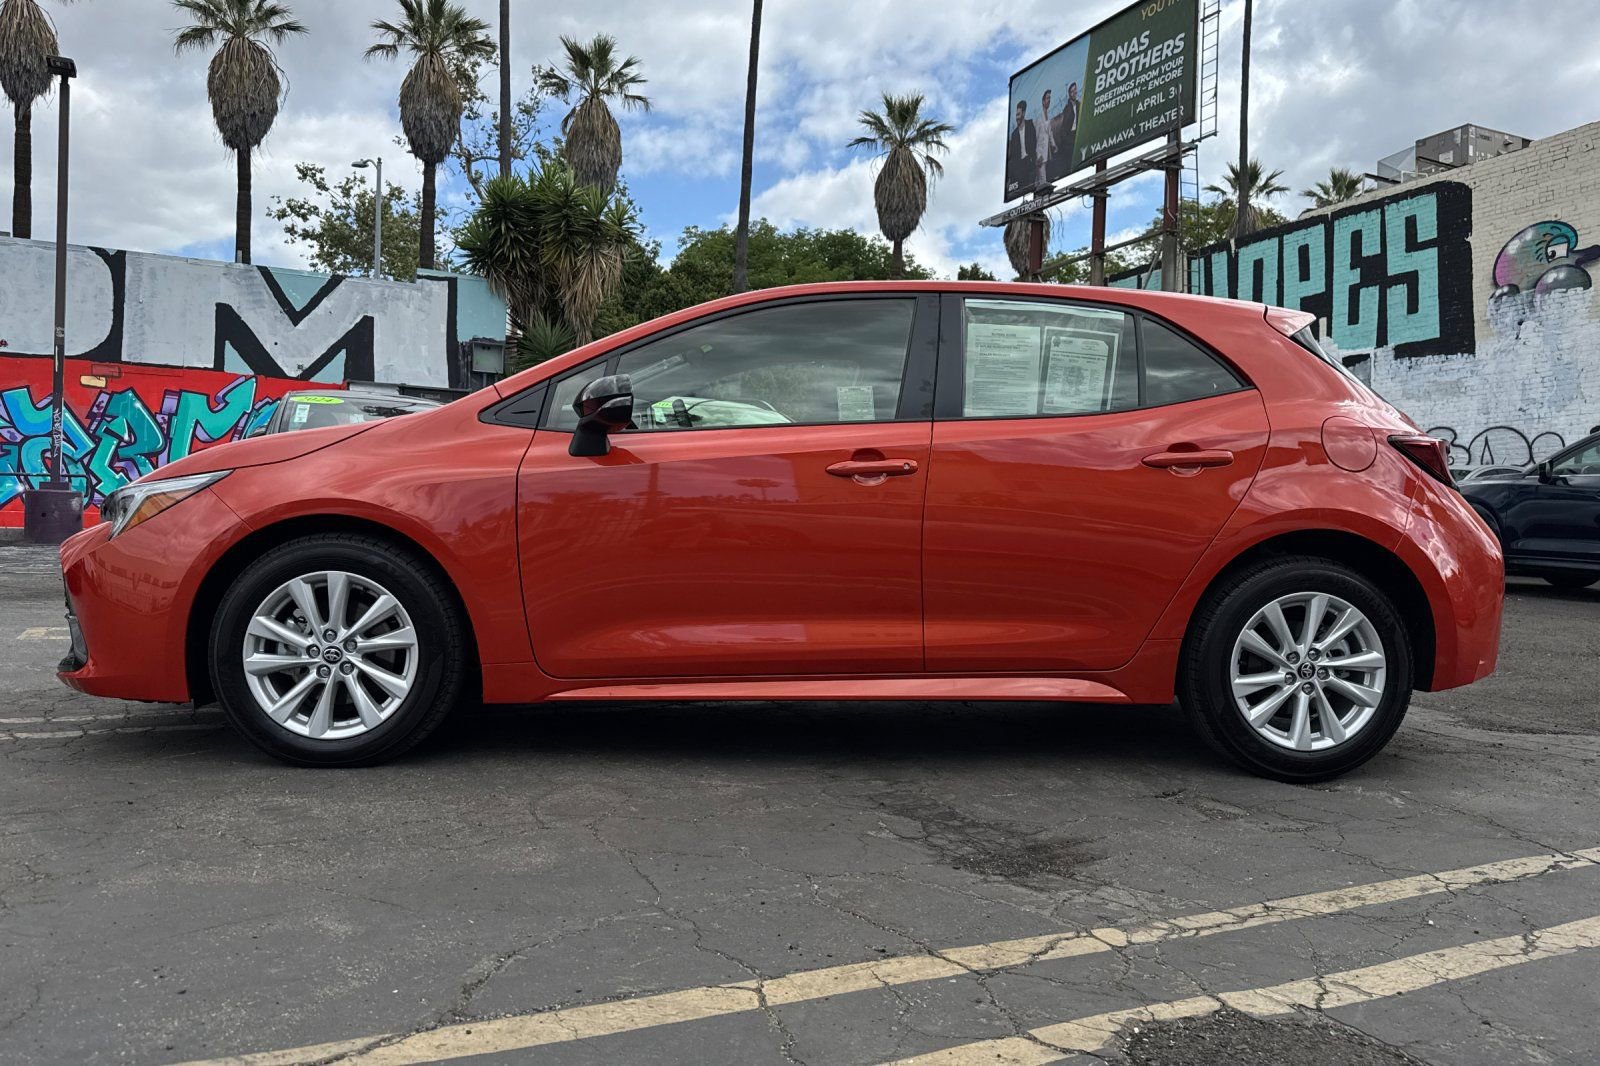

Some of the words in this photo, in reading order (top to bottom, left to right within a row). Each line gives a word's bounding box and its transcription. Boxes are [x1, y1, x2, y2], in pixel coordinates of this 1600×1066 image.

[1095, 30, 1150, 74] JONAS
[1095, 33, 1185, 93] BROTHERS
[1094, 79, 1135, 106] GREETINGS
[1135, 67, 1159, 86] FROM
[1161, 56, 1184, 74] YOUR
[1094, 87, 1141, 116] HOMETOWN
[1147, 67, 1184, 91] ENCORE
[1136, 91, 1166, 114] APRIL
